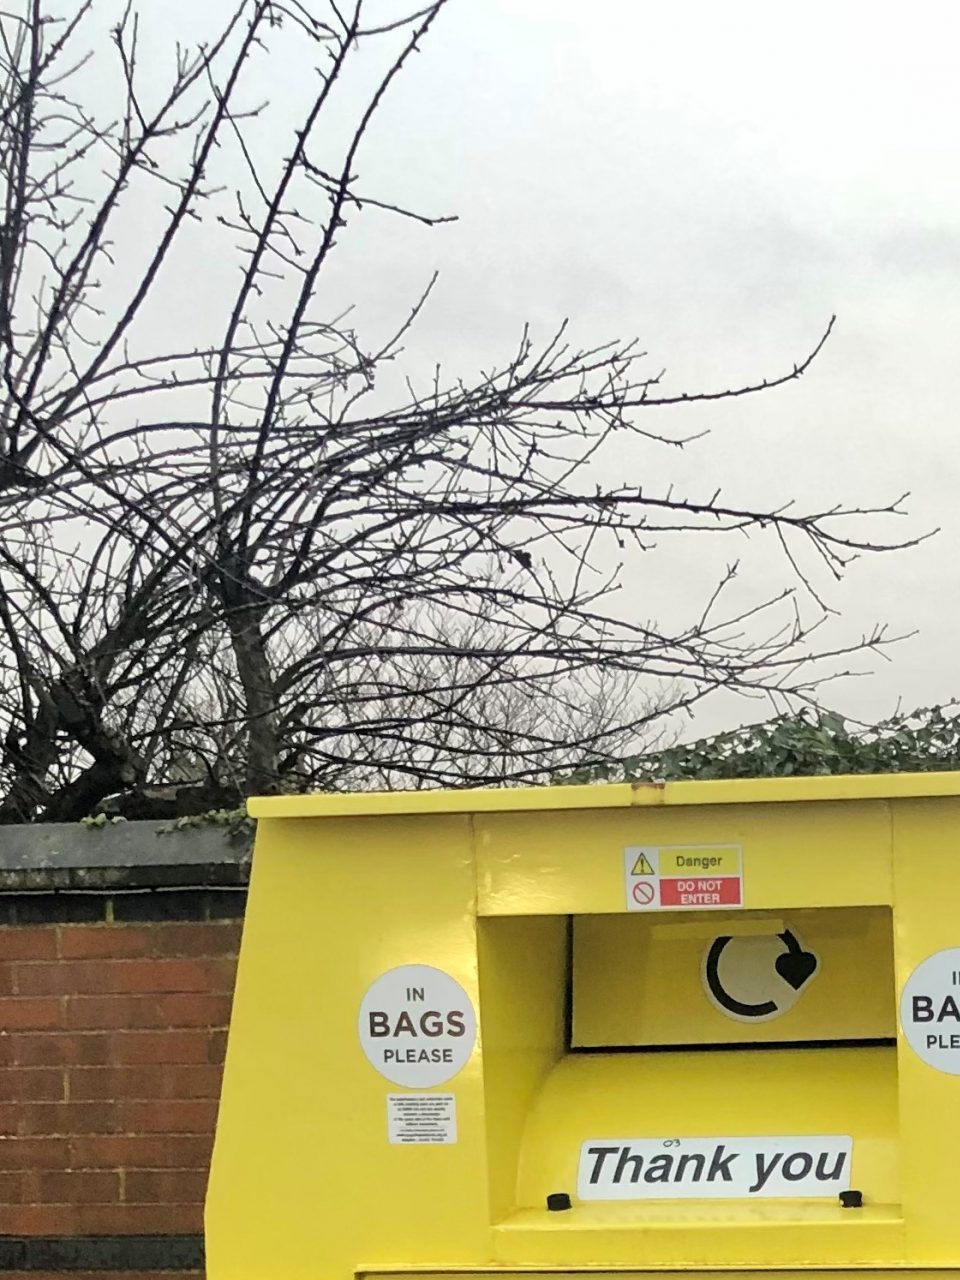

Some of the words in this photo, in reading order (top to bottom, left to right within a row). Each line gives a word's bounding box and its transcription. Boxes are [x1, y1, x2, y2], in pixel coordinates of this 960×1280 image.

[676, 855, 723, 870] Danger
[677, 880, 695, 892] DO
[698, 880, 723, 891] NOT
[680, 893, 720, 904] ENTER
[406, 987, 425, 1002] IN
[368, 1010, 466, 1038] BAGS
[383, 1048, 454, 1063] PLEASE
[587, 1145, 741, 1184] Thank
[748, 1151, 847, 1193] you
